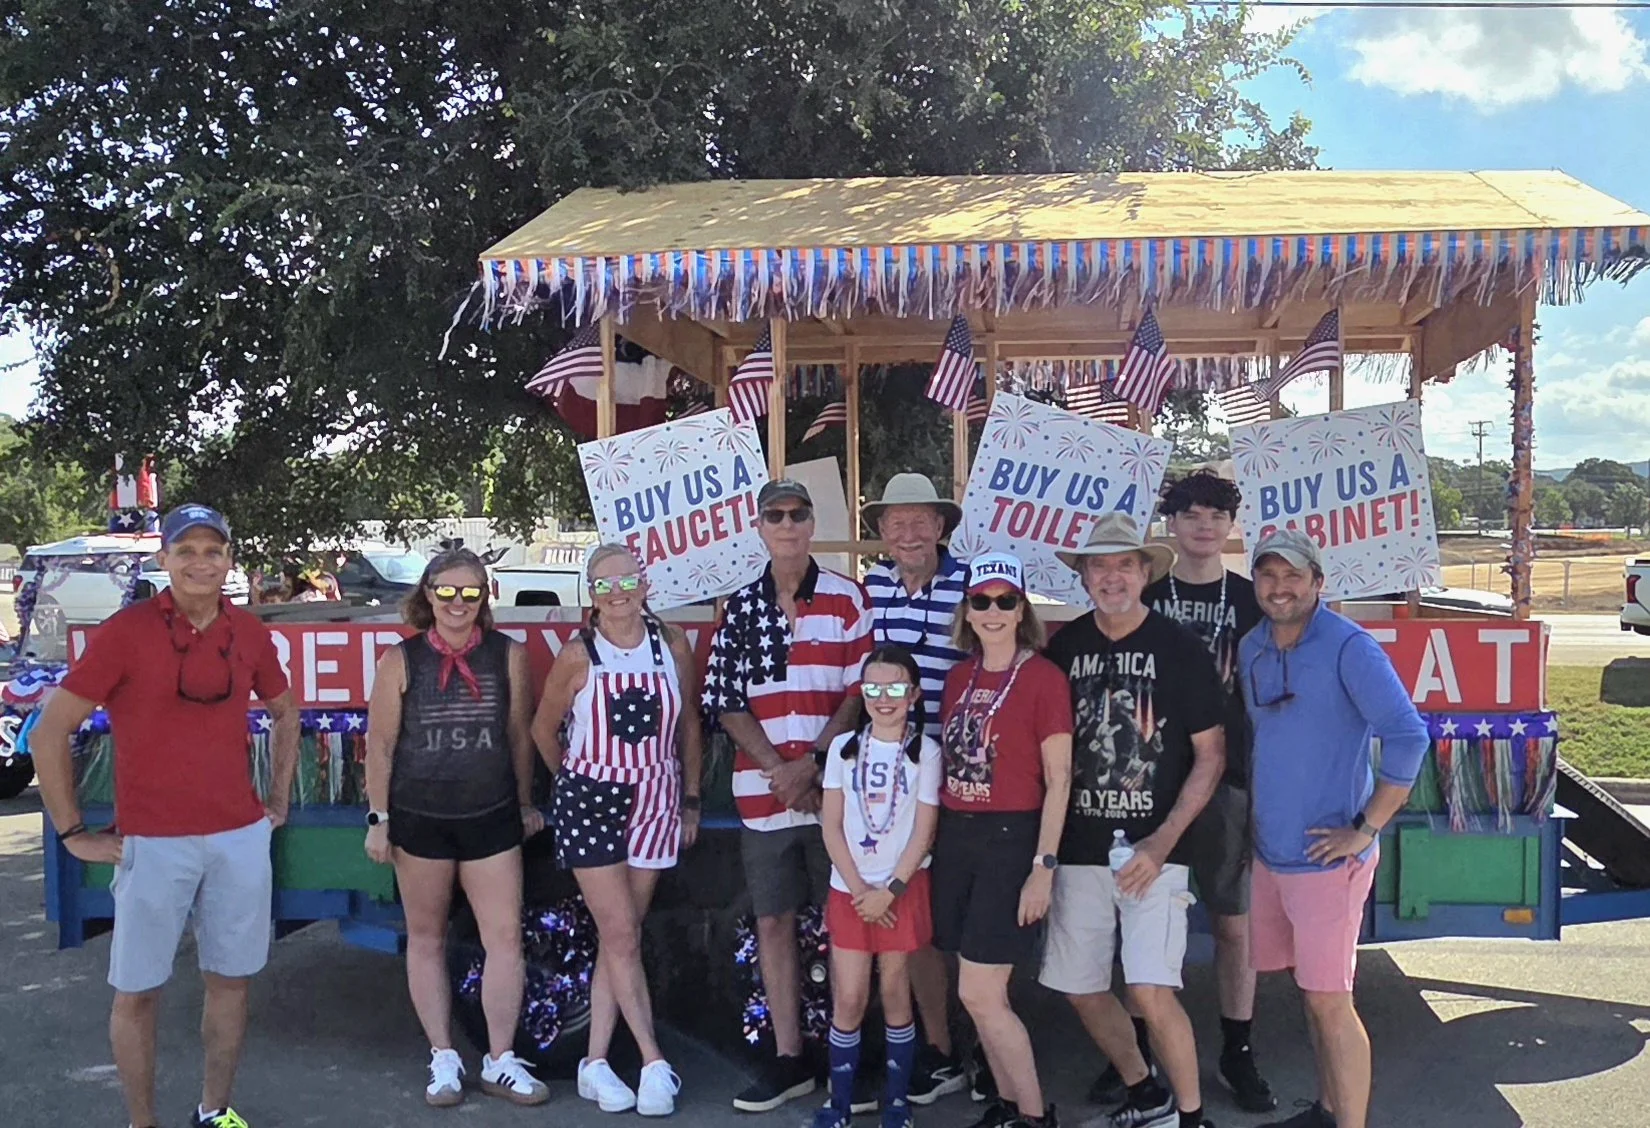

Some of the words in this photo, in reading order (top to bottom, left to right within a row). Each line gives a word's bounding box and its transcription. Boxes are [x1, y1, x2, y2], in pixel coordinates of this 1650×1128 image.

[614, 480, 671, 532] BUY
[683, 464, 723, 506] US
[732, 454, 752, 490] A
[988, 457, 1060, 499] BUY
[1065, 472, 1109, 510] US
[1113, 483, 1137, 515] A
[1260, 472, 1323, 521] BUY
[1336, 460, 1378, 501] US
[1389, 452, 1410, 490] A
[988, 495, 1100, 549] TOILE
[976, 563, 1017, 578] TEXANS
[1095, 789, 1154, 811] YEARS
